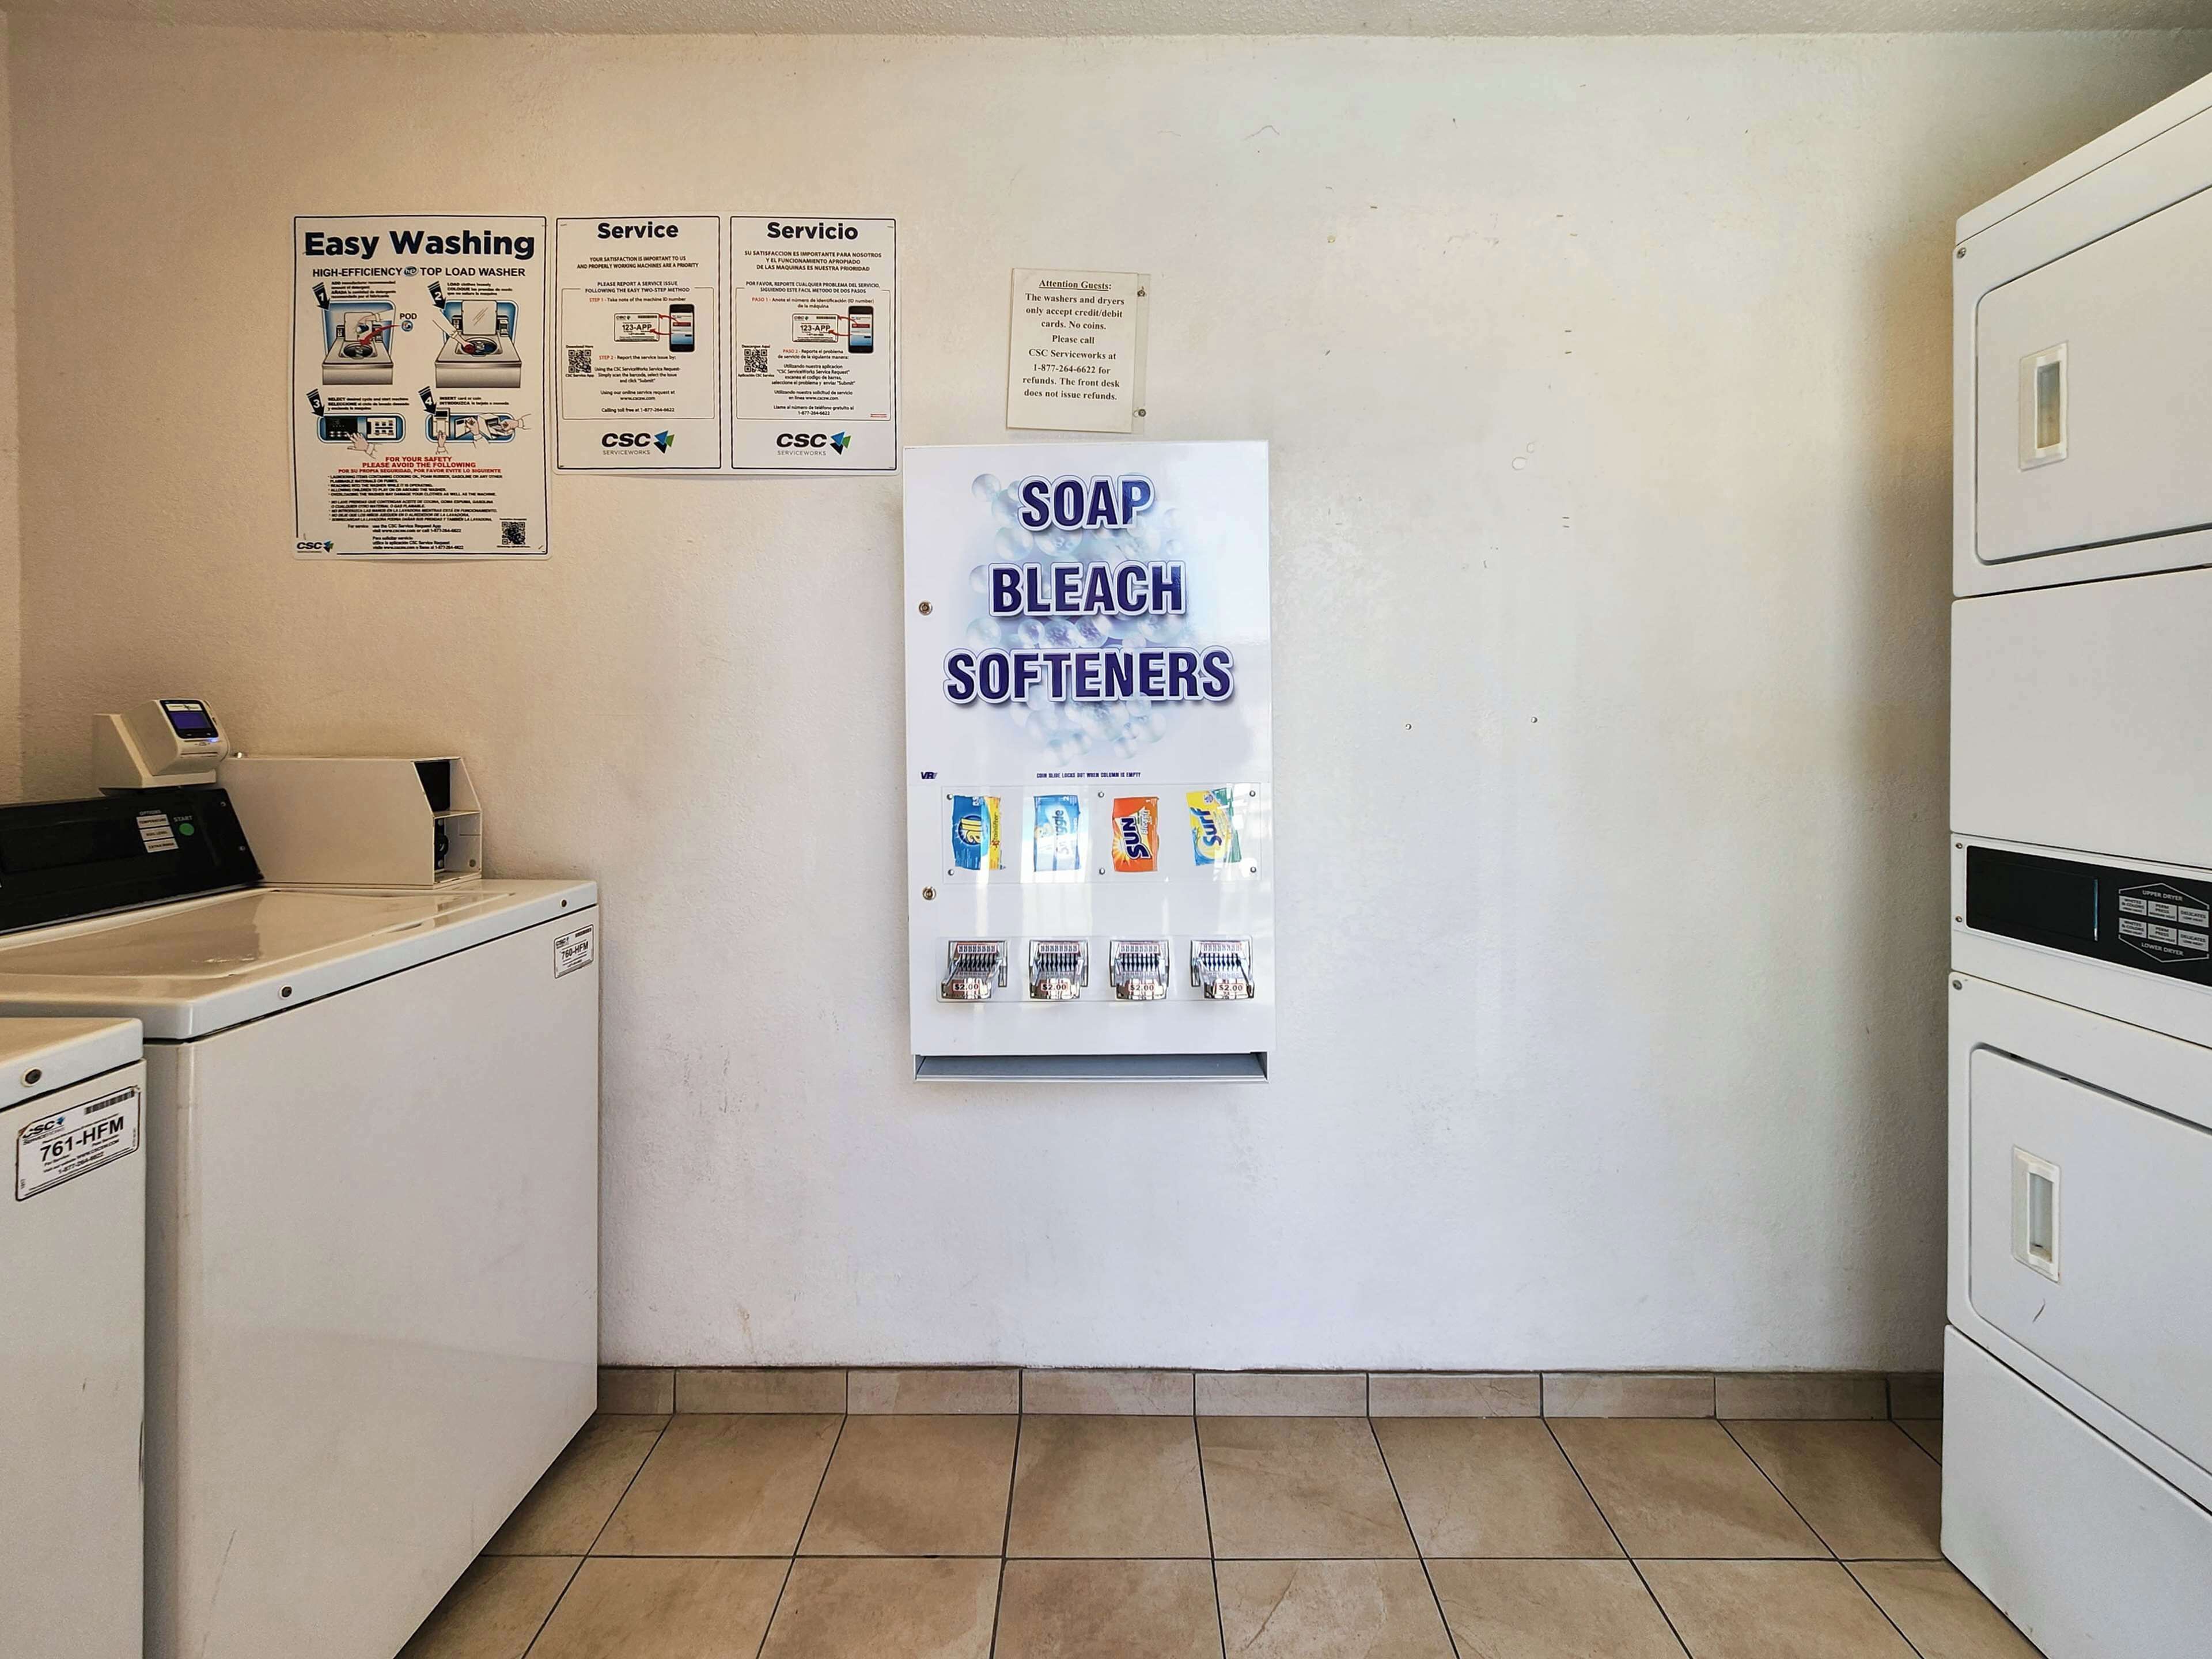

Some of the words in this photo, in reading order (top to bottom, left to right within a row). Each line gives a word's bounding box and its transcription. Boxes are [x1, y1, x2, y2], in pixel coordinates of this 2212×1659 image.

[598, 222, 678, 238] Service
[767, 222, 858, 239] Servicio
[304, 232, 380, 259] Easy
[389, 230, 534, 259] Washing
[313, 268, 402, 276] HIGH-EFFICIENCY
[420, 267, 442, 275] TOP
[446, 268, 475, 276] LOAD
[479, 268, 525, 276] WASHER
[1039, 280, 1078, 289] Attention
[1080, 281, 1111, 290] Guests:
[319, 293, 324, 301] 1
[435, 292, 441, 300] 2
[1097, 297, 1124, 306] dryers
[1026, 307, 1043, 316] only
[1075, 309, 1122, 317] credit/debit
[1051, 350, 1105, 359] Serviceworks
[1035, 364, 1095, 373] 1-877-264-6622
[1078, 378, 1098, 387] front
[1084, 392, 1117, 400] refunds.
[313, 399, 320, 408] 3
[602, 433, 651, 447] CSC
[777, 434, 827, 448] CSC
[1020, 478, 1152, 528] SOAP
[991, 563, 1183, 614] BLEACH
[946, 649, 1234, 700] SOFTENERS
[961, 818, 982, 844] all
[1189, 806, 1222, 846] Surf
[1121, 817, 1149, 858] SUN
[2181, 934, 2206, 942] DELICATES
[562, 941, 588, 959] 760-HFM
[2142, 942, 2162, 951] LOWER
[2164, 948, 2183, 956] DRYER
[40, 1116, 124, 1162] 761-HFM
